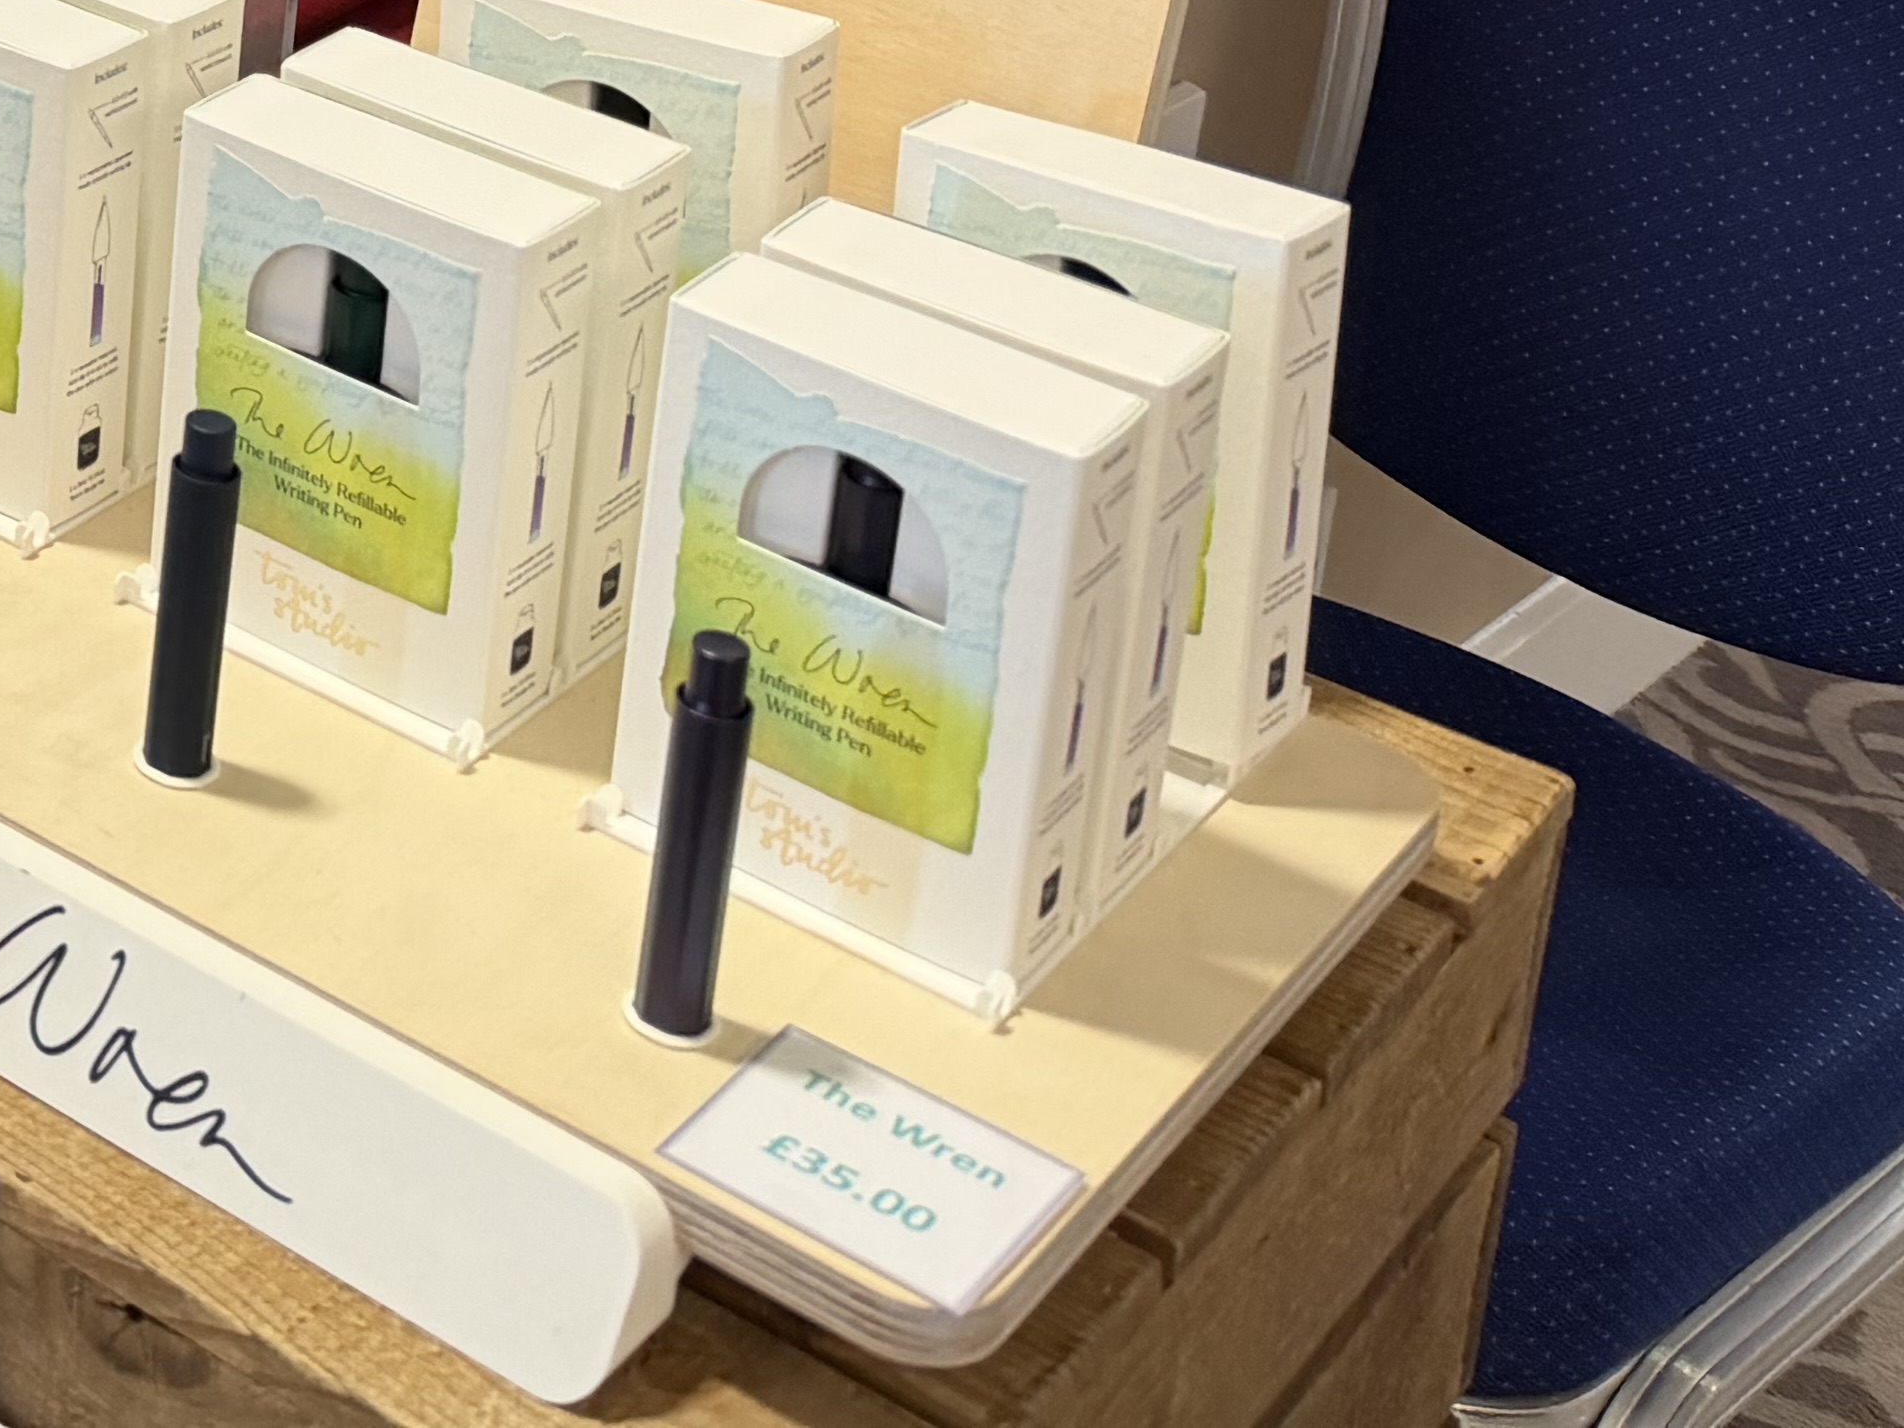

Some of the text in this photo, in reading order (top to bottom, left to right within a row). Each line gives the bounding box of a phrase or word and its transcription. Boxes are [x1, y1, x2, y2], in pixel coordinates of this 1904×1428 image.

[235, 435, 407, 530] The Infinitely Refillable
[272, 471, 364, 532] Writing Pen
[758, 663, 928, 759] Infinitely Refillable
[764, 689, 874, 760] Writing Pen
[804, 1068, 1007, 1191] The Wren
[762, 1134, 938, 1234] £35.00
